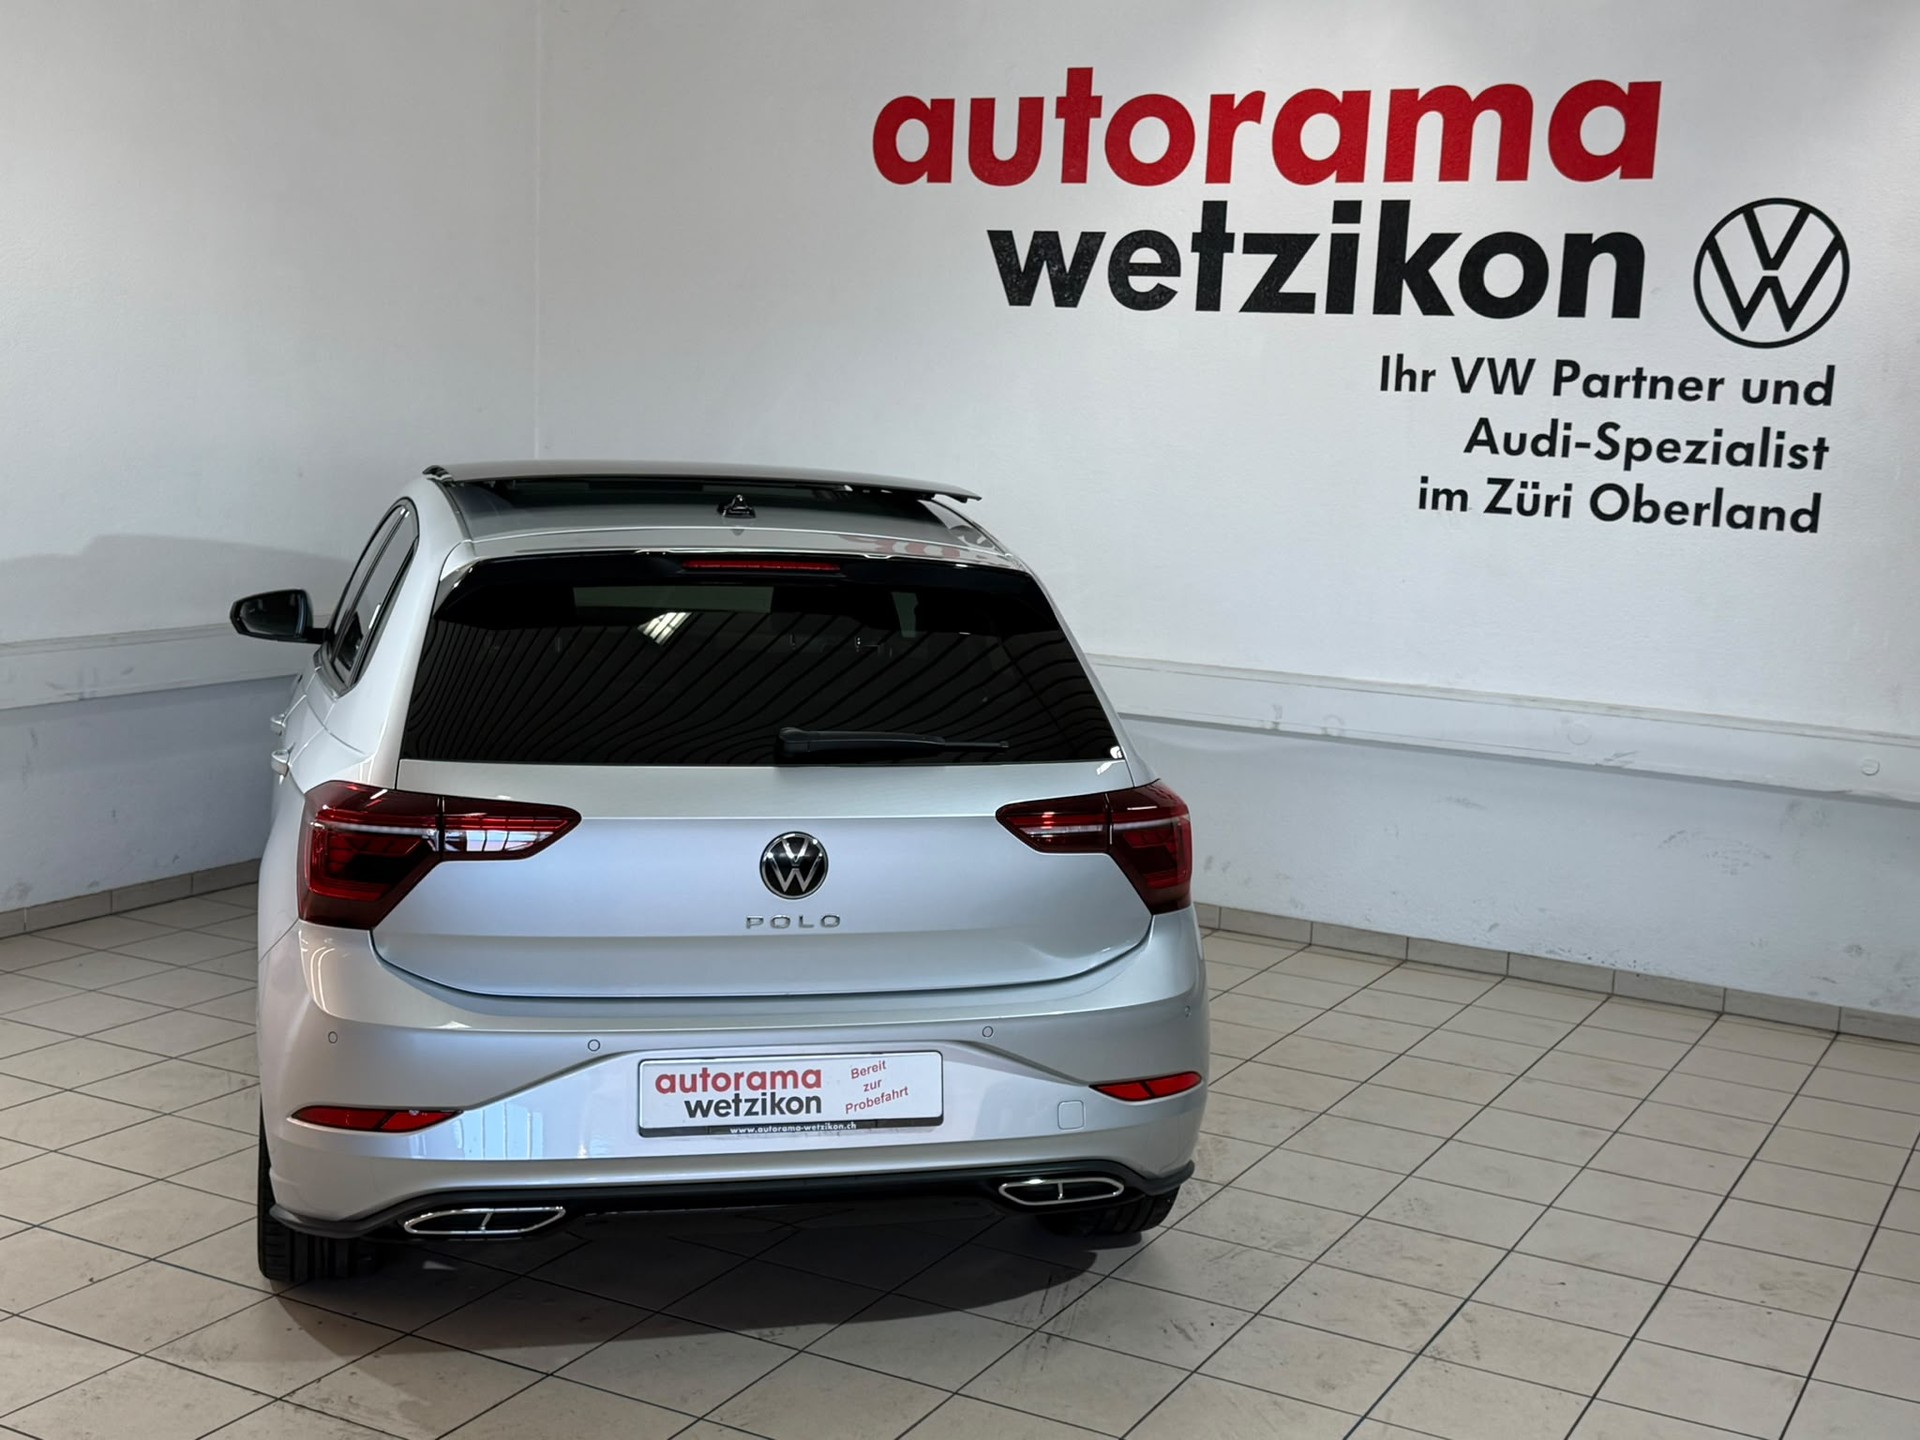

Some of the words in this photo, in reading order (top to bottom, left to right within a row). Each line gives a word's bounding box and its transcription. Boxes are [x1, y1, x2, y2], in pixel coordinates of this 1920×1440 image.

[872, 66, 1663, 188] autorama
[986, 199, 1646, 320] wetzikon
[1379, 353, 1437, 393] Ihr
[1450, 355, 1537, 396] VW
[1552, 358, 1726, 403] Partner
[1740, 364, 1836, 407] und
[1462, 416, 1830, 472] Audi-Spezialist
[1418, 475, 1469, 513] im
[1482, 476, 1574, 519] Züri
[1588, 482, 1823, 534] Oberland
[745, 914, 841, 930] POLO
[655, 1067, 823, 1095] autorama
[850, 1060, 887, 1080] Bereit
[862, 1077, 882, 1093] zur
[684, 1092, 823, 1119] wetzikon
[845, 1086, 909, 1115] Probefahrt
[729, 1121, 858, 1135] www.autorama-wetzikon.ch
